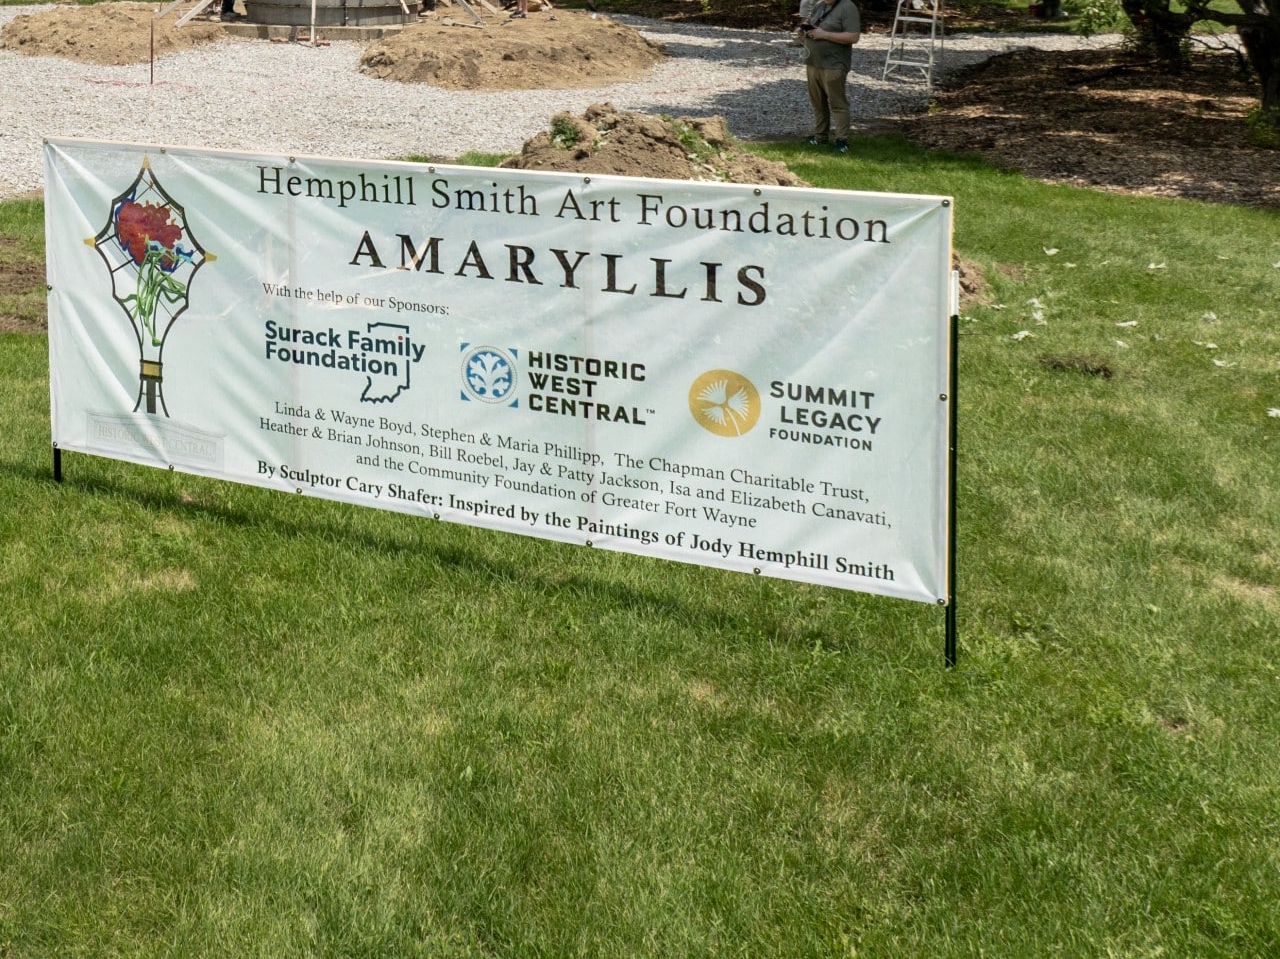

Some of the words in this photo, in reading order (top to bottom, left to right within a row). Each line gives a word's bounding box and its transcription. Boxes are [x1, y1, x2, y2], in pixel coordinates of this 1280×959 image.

[257, 166, 416, 207] Hemphill
[431, 179, 539, 216] Smith
[555, 188, 620, 222] Art
[636, 194, 890, 244] Foundation
[348, 230, 767, 306] AMARYLLIS
[262, 283, 291, 298] With
[294, 286, 313, 300] the
[317, 289, 342, 305] help
[346, 292, 360, 305] of
[364, 296, 385, 307] our
[388, 296, 450, 315] Sponsors:
[265, 320, 341, 347] Surack
[348, 330, 426, 362] Family
[266, 341, 398, 376] Foundation
[528, 372, 597, 398] WEST
[529, 351, 646, 382] HISTORIC
[770, 380, 875, 410] SUMMIT
[780, 406, 882, 435] LEGACY
[275, 402, 311, 419] Linda
[314, 408, 326, 421] &
[330, 411, 375, 429] Wayne
[379, 417, 417, 436] Boyd,
[421, 423, 475, 445] Stephen
[479, 433, 492, 446] &
[497, 435, 539, 454] Maria
[544, 442, 605, 466] Phillipp,
[614, 452, 644, 469] The
[648, 457, 725, 482] Chapman
[730, 469, 815, 494] Charitable
[820, 480, 870, 503] Trust,
[769, 428, 873, 452] FOUNDATION
[259, 418, 308, 438] Heather
[311, 426, 323, 439] &
[327, 428, 362, 445] Brian
[365, 434, 425, 457] Johnson,
[429, 444, 452, 460] Bill
[457, 449, 508, 471] Roebel,
[512, 457, 536, 477] Jay
[539, 463, 553, 476] &
[557, 465, 595, 486] Patty
[599, 471, 664, 494] Jackson,
[669, 480, 691, 497] Isa
[696, 485, 725, 502] and
[731, 490, 807, 514] Elizabeth
[811, 502, 892, 529] Canavati,
[356, 453, 380, 468] and
[384, 457, 405, 471] the
[408, 461, 490, 488] Community
[494, 474, 577, 501] Foundation
[580, 490, 597, 503] of
[601, 492, 659, 513] Greater
[664, 501, 697, 519] Fort
[702, 506, 758, 529] Wayne
[257, 460, 276, 478] By
[280, 463, 342, 488] Sculptor
[346, 476, 383, 498] Cary
[387, 482, 443, 507] Shafer:
[448, 494, 516, 519] Inspired
[521, 505, 540, 526] by
[544, 512, 571, 528] the
[576, 515, 660, 545] Paintings
[664, 530, 685, 548] of
[689, 534, 733, 559] Jody
[738, 541, 829, 571] Hemphill
[835, 556, 896, 582] Smith
